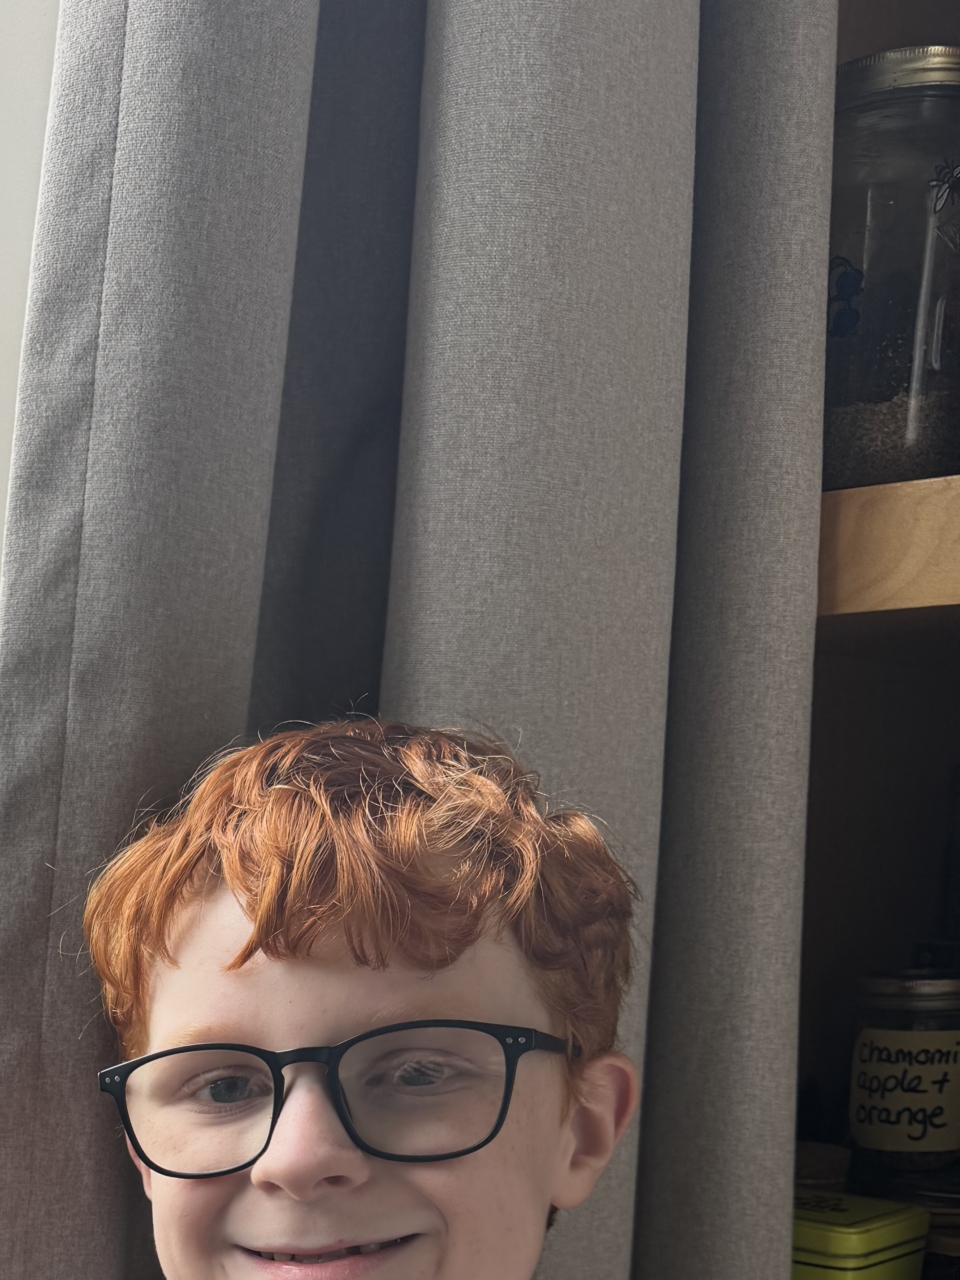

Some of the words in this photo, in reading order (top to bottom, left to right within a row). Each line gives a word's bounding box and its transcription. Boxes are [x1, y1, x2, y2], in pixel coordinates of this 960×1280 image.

[857, 1069, 928, 1099] apple
[931, 1071, 951, 1094] +
[855, 1103, 947, 1141] orange
